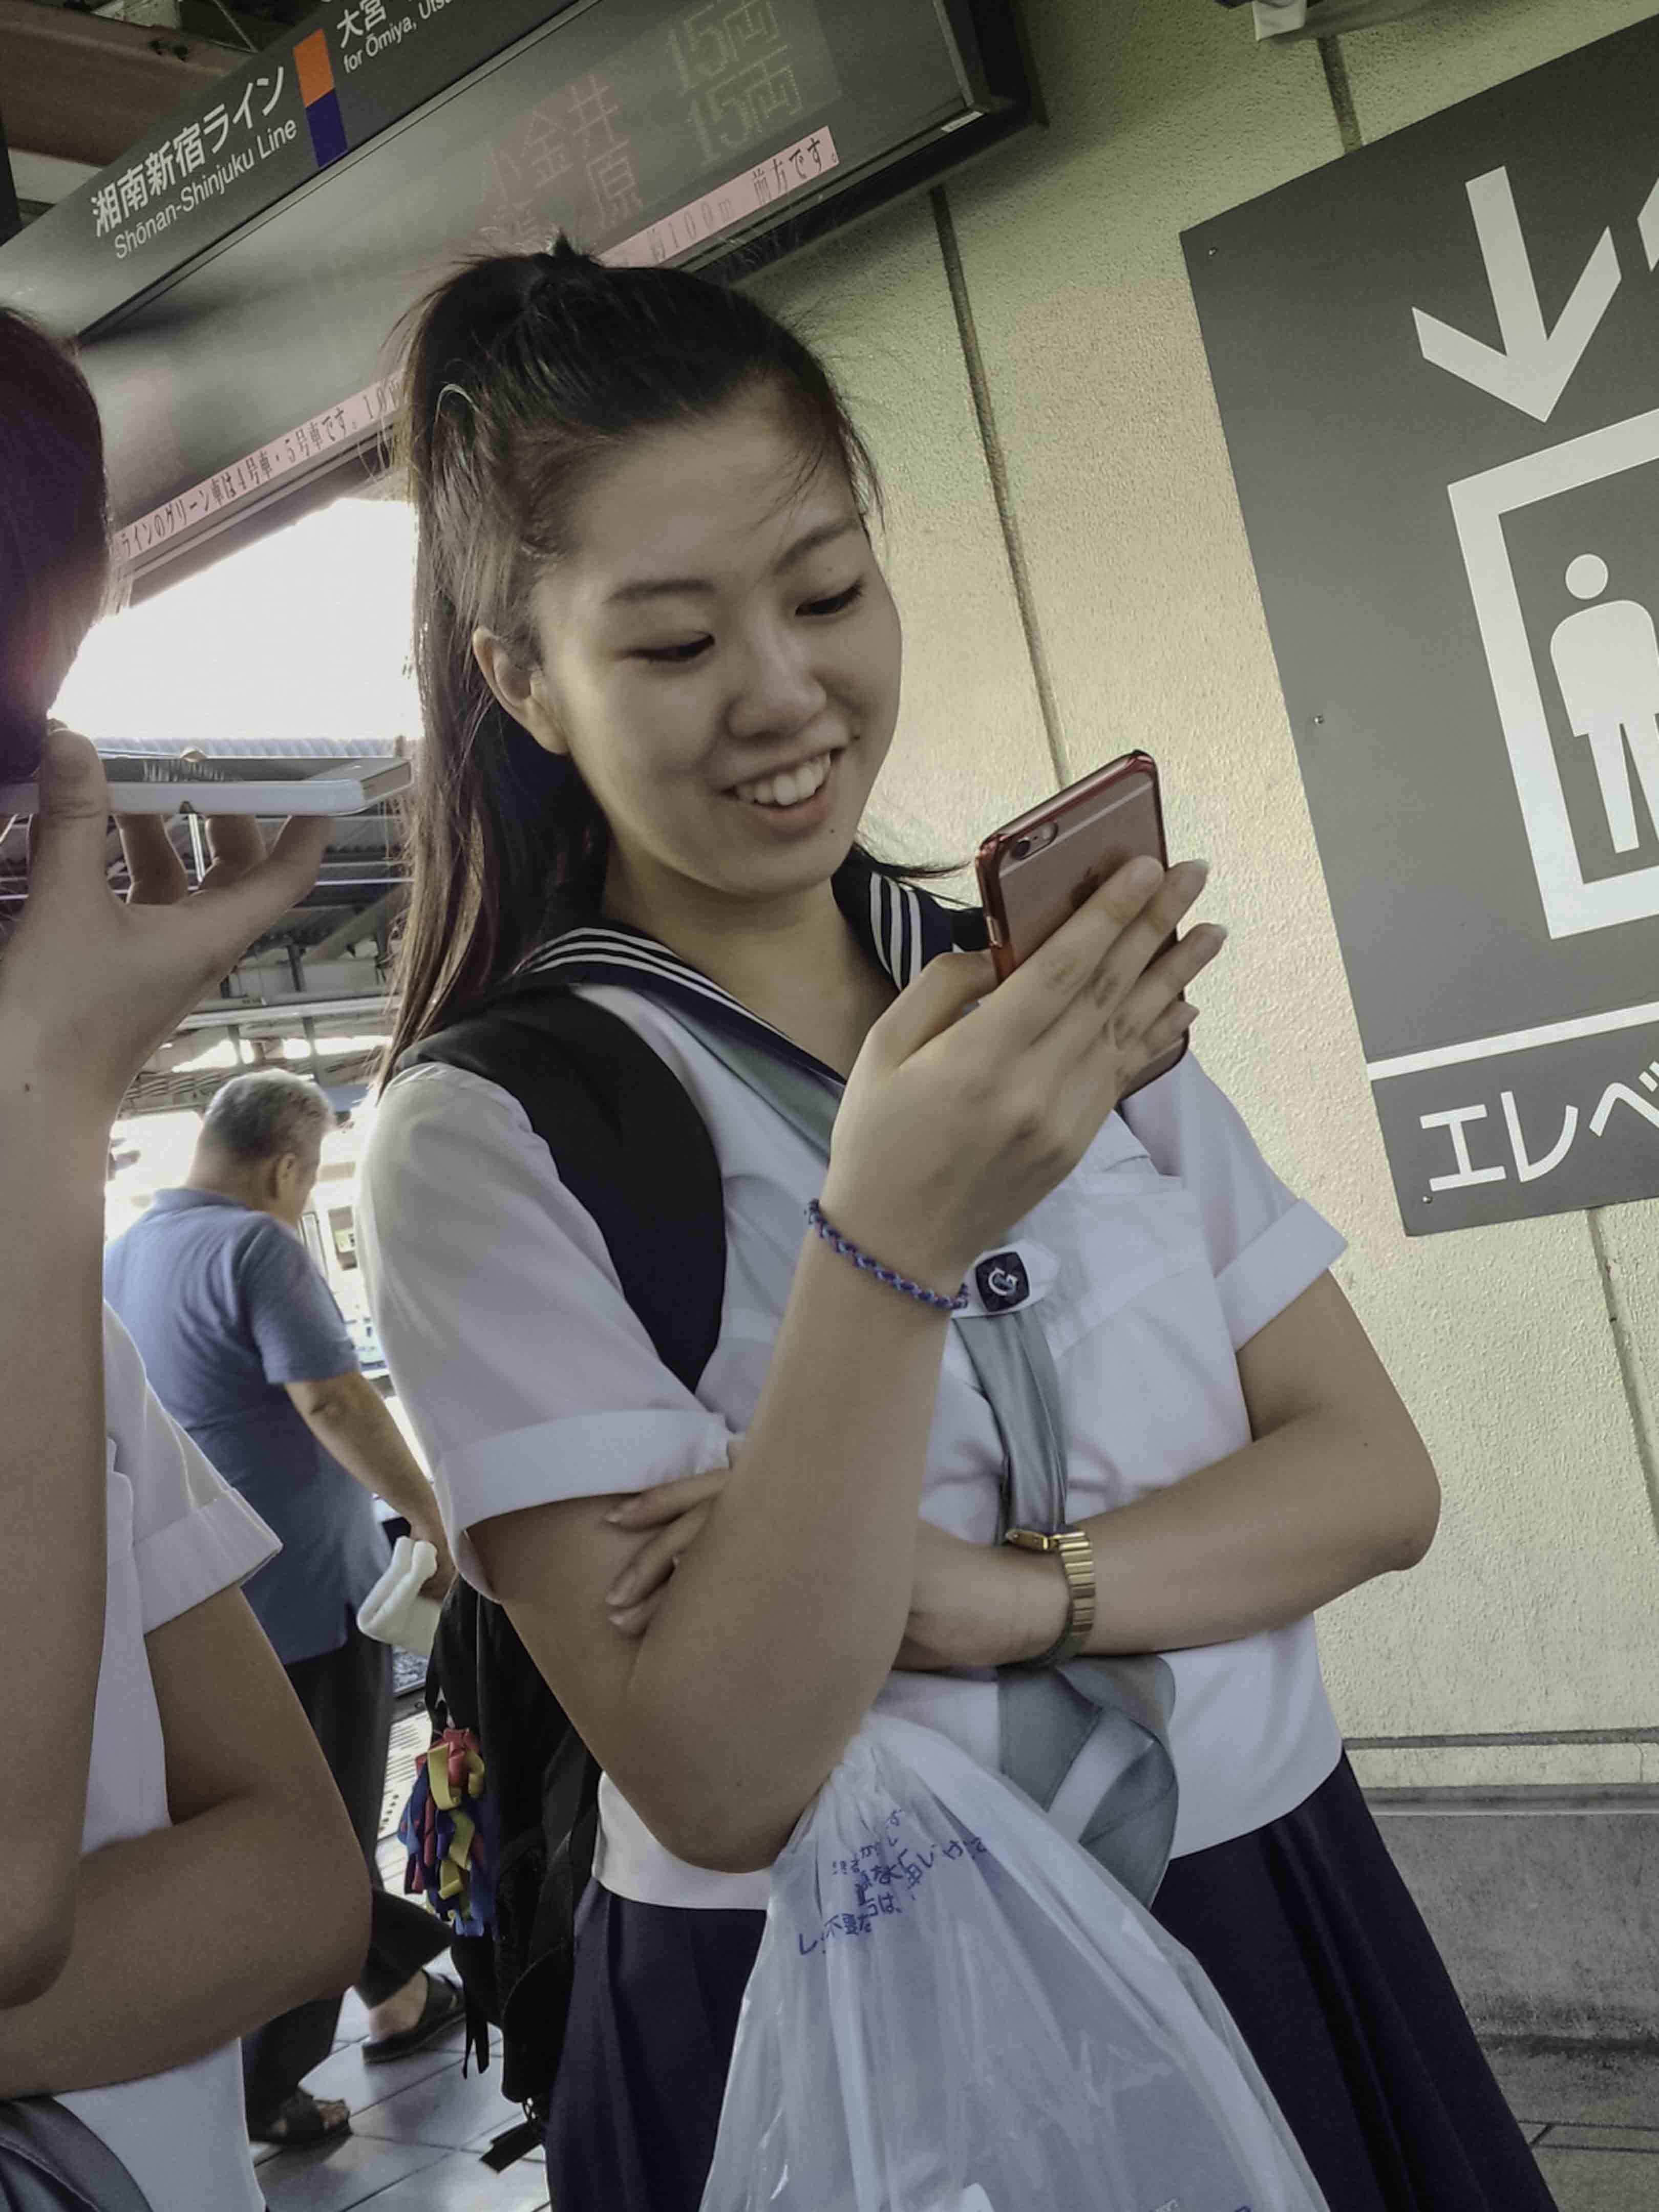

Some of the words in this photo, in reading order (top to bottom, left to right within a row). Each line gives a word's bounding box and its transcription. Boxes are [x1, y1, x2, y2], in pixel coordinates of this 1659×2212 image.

[344, 49, 363, 73] for
[365, 16, 416, 57] Ōmiya,
[91, 67, 284, 237] 湘南新宿ライン
[114, 147, 254, 259] Shōnan-Shinjuku
[257, 119, 297, 160] Line
[1419, 1060, 1659, 1192] エレベ
